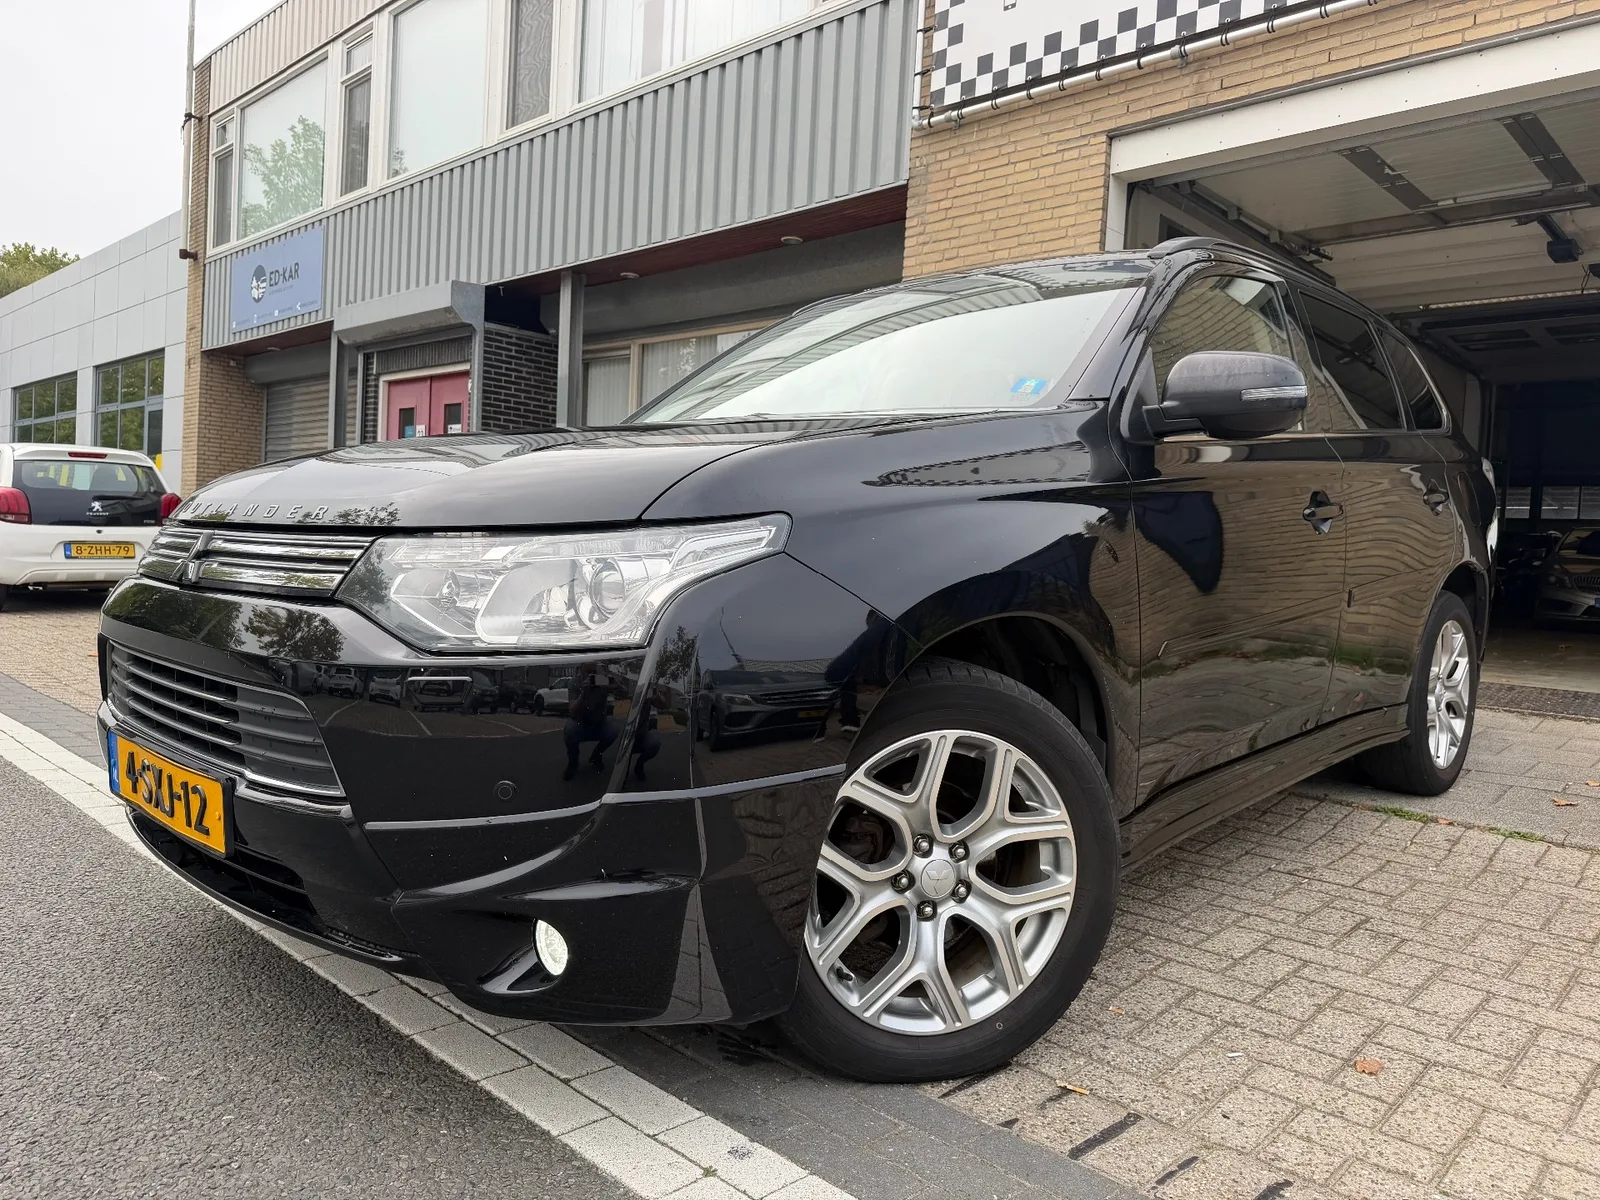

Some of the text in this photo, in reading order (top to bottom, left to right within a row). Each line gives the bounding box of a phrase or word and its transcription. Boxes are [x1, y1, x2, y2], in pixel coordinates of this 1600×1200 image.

[182, 501, 329, 520] OUTLANDER
[75, 545, 130, 556] 8-ZHH-79
[126, 751, 210, 836] 4-SXJ-12
